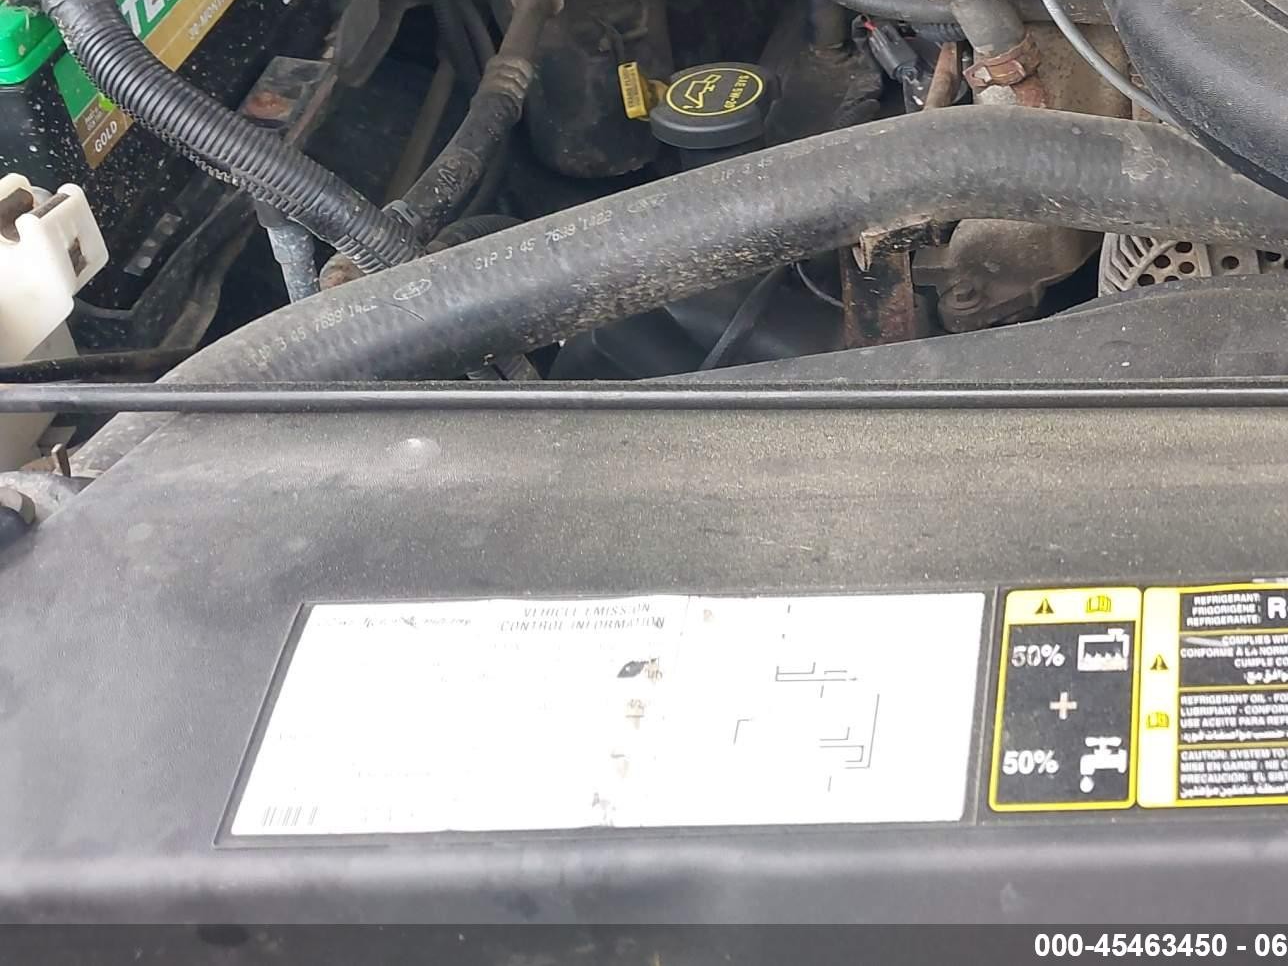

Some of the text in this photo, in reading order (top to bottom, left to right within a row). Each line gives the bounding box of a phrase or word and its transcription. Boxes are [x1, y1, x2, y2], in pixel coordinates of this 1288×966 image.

[95, 120, 117, 153] GOLD
[505, 246, 513, 260] 3
[519, 237, 536, 252] 45
[585, 602, 650, 618] EMISSON
[1011, 643, 1065, 667] 50%
[1002, 749, 1059, 775] 50%
